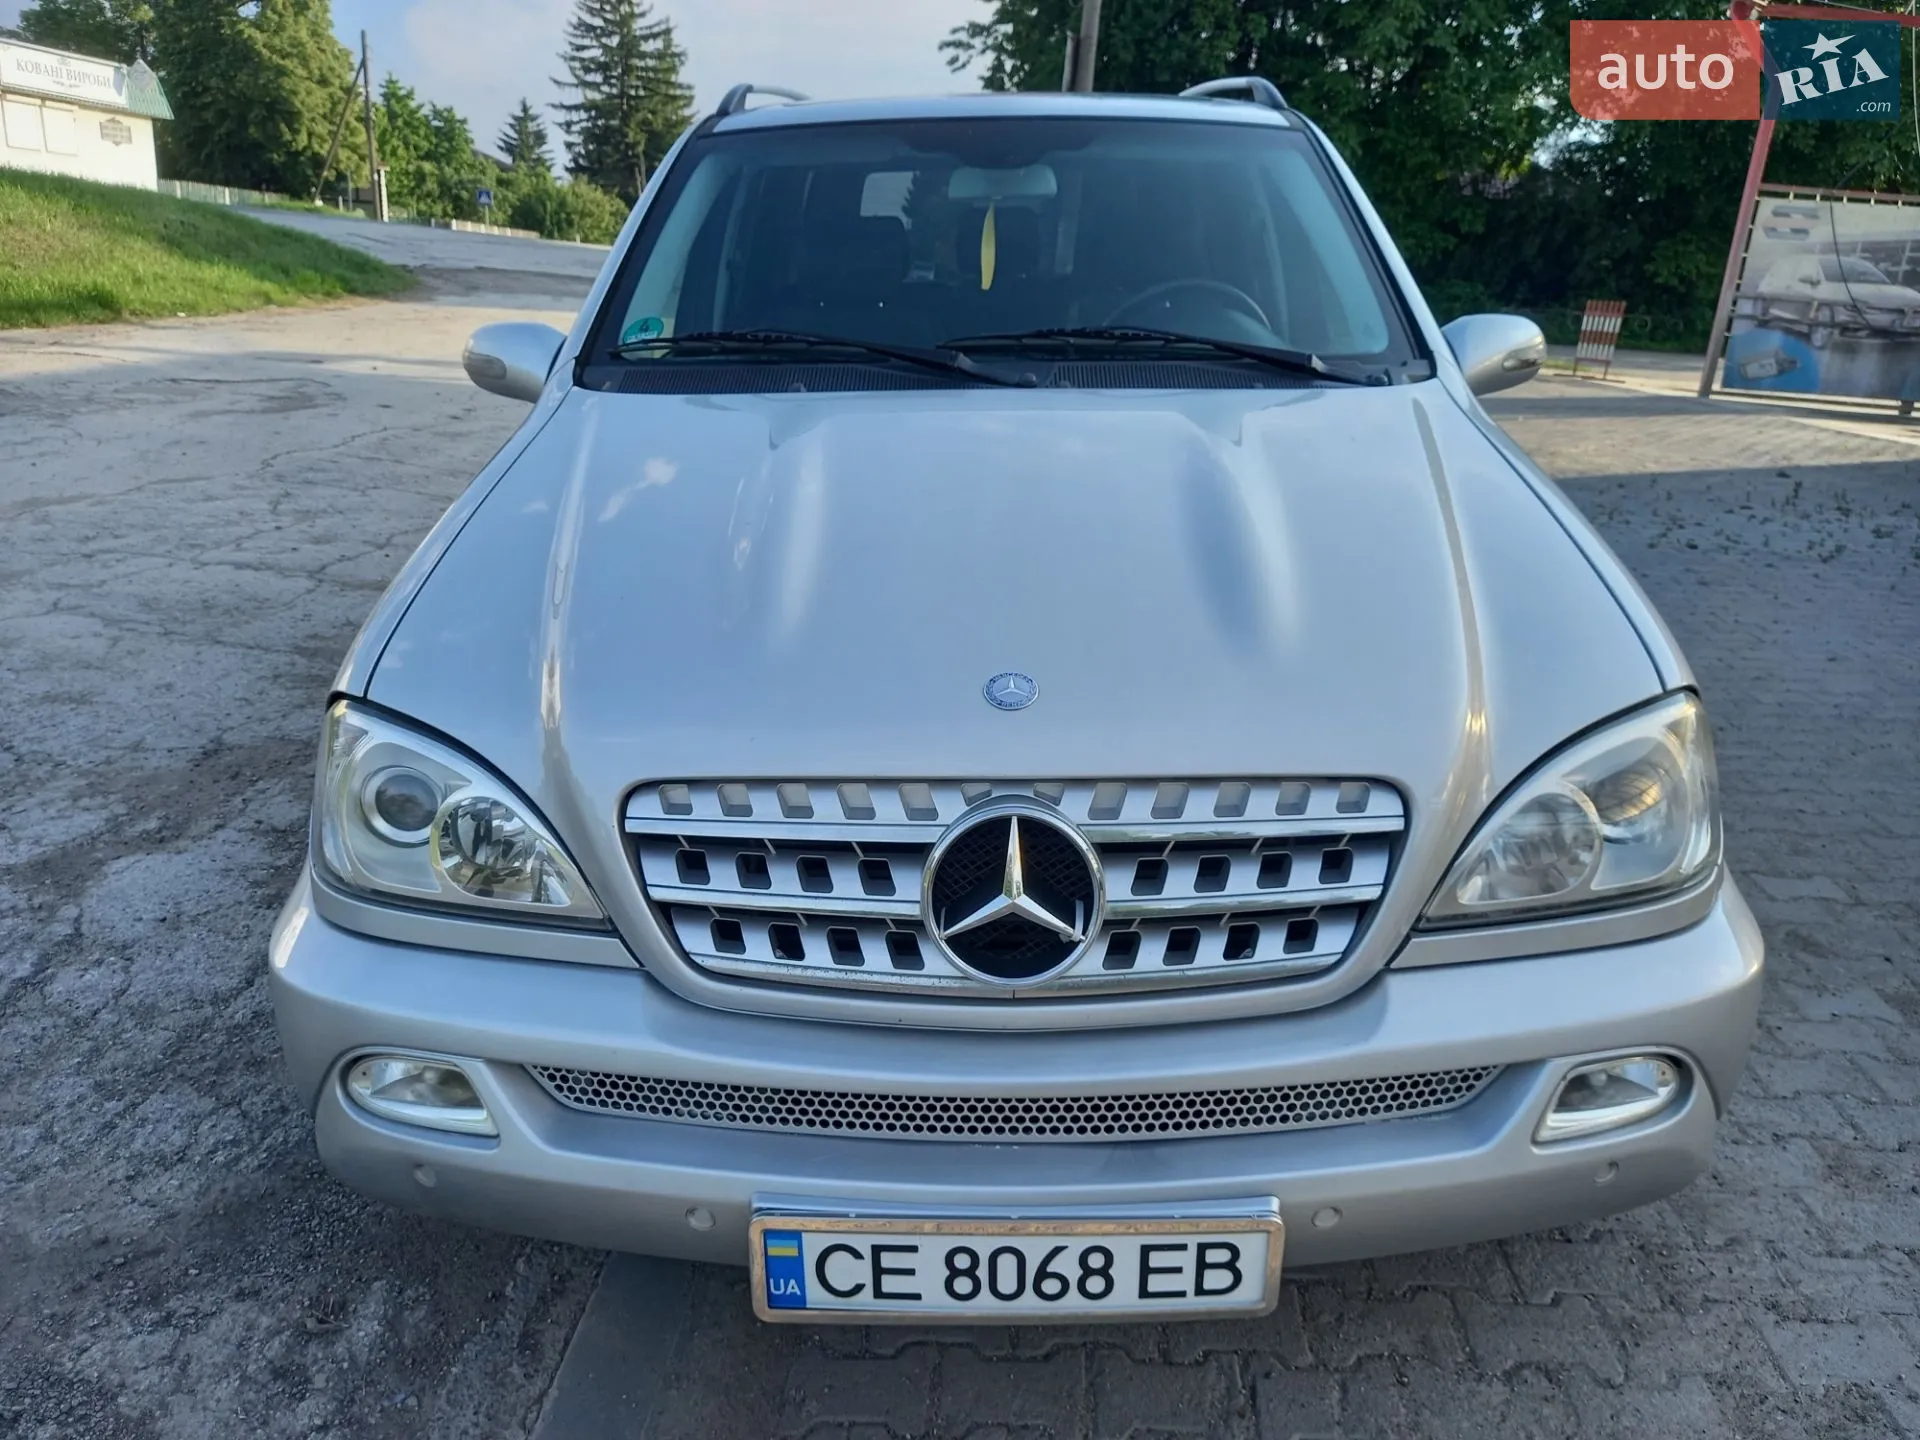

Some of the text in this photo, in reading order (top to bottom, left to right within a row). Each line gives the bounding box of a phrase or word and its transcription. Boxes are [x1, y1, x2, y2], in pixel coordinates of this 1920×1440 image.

[16, 58, 111, 88] КОВАНІ ВИРОБИ
[769, 1277, 801, 1296] UA
[815, 1241, 1242, 1302] CE 8068 EB
